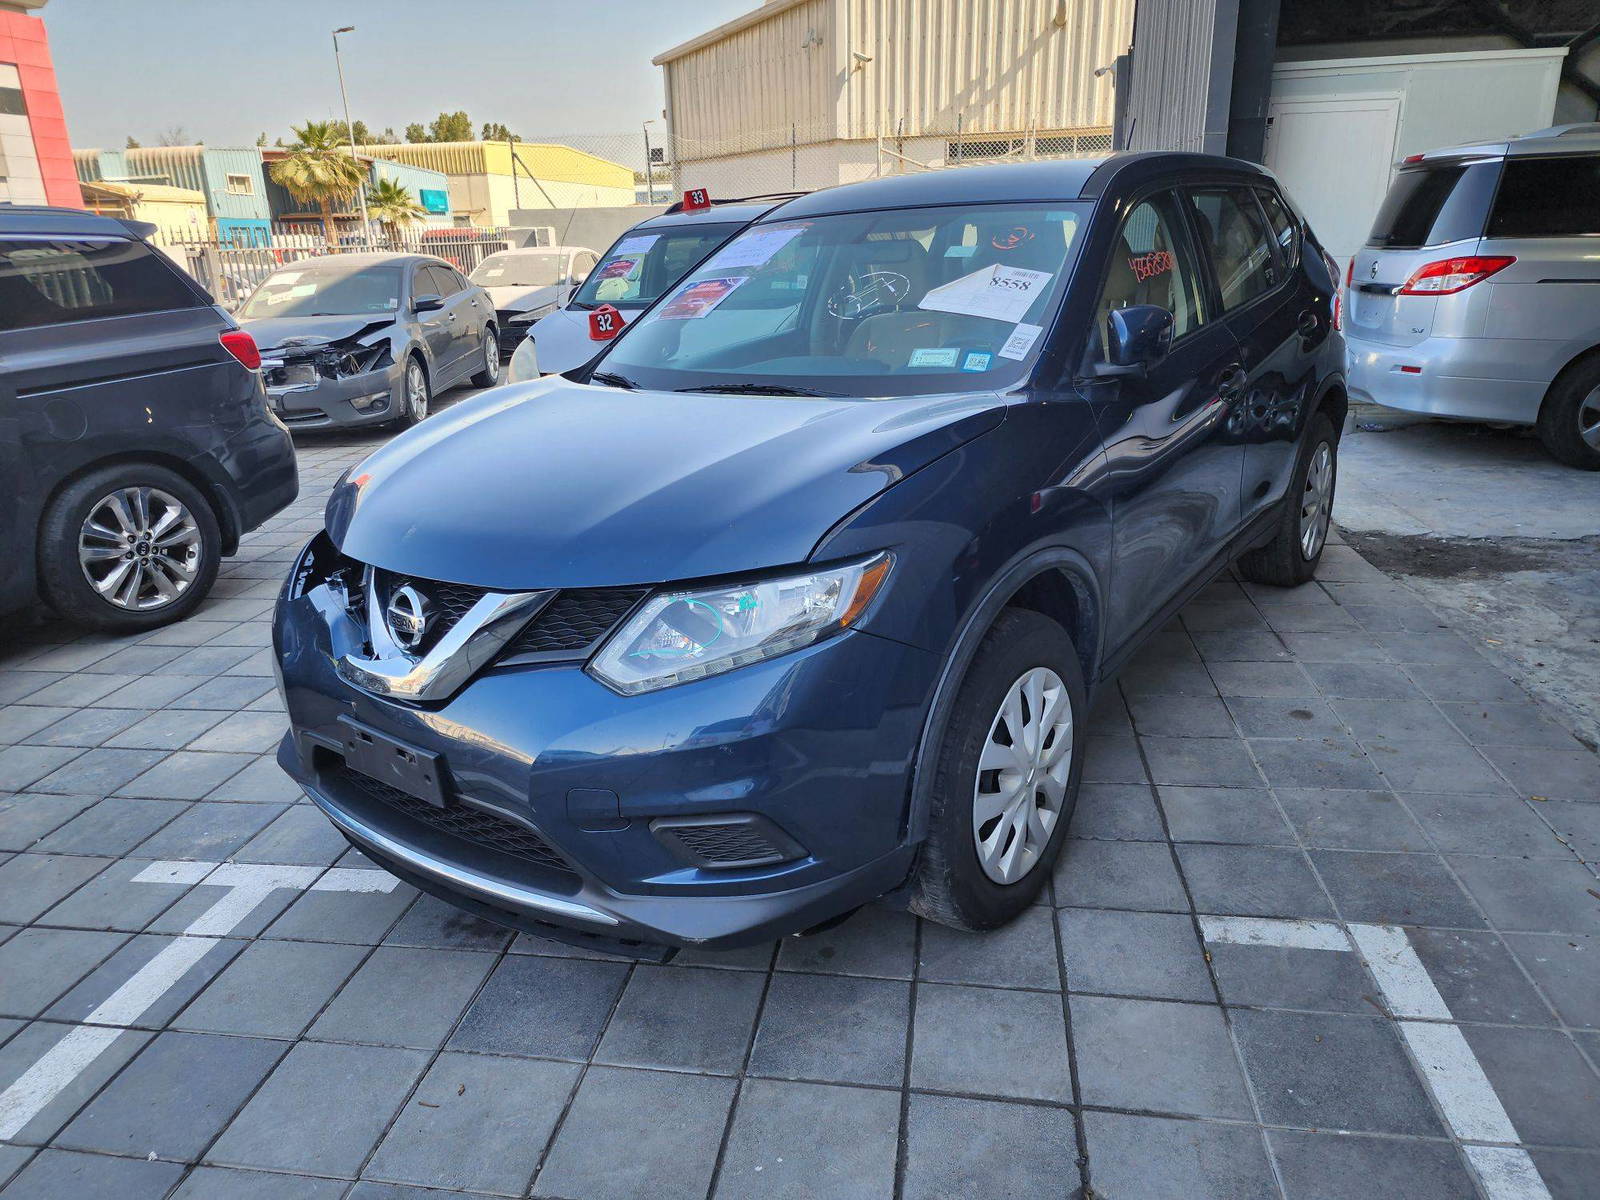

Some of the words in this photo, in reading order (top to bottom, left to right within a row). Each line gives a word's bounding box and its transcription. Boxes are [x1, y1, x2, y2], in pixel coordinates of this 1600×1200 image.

[691, 190, 705, 205] 33
[989, 277, 1031, 291] 8558
[597, 313, 614, 332] 32
